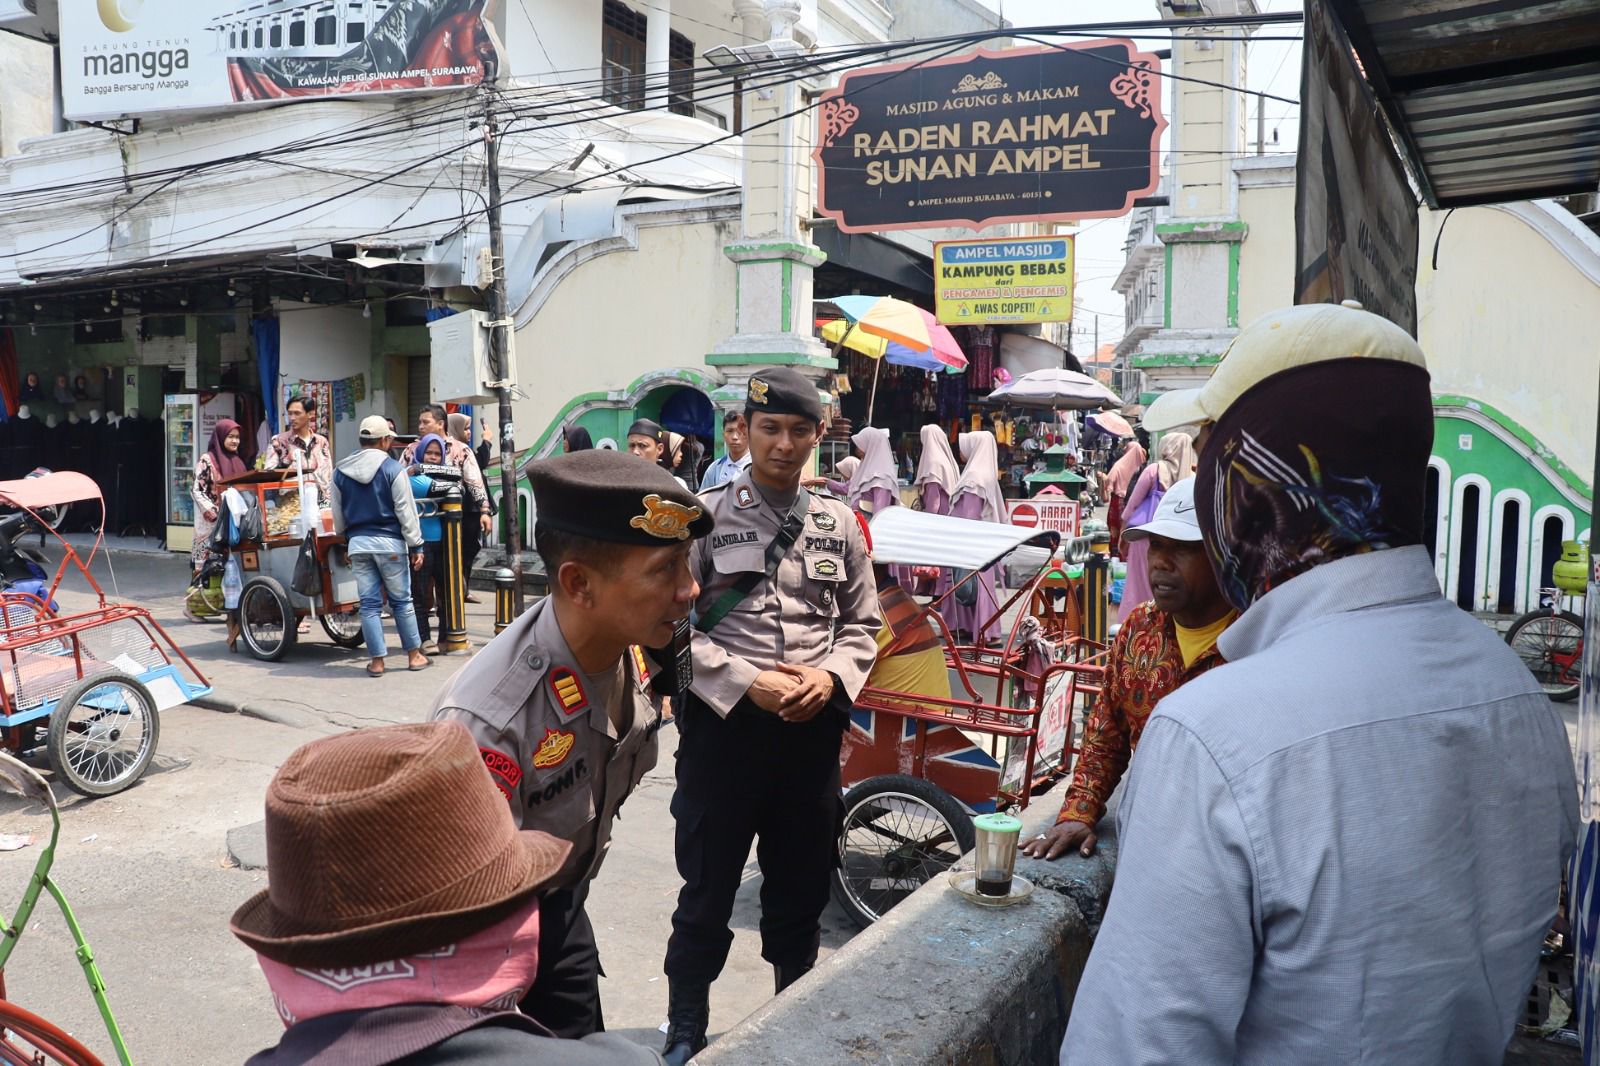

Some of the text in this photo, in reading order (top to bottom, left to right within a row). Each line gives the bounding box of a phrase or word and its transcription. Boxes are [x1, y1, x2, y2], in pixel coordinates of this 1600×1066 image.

[83, 38, 190, 52] SARUNG TENUN
[84, 48, 189, 78] mangga
[298, 65, 477, 86] KAWASAN RELIGI SUNAN AMPEL SURABAYA
[84, 79, 189, 95] Bangga Bersarung Mangga
[886, 85, 1080, 117] MASJID AGUNG & MAKAM
[854, 109, 1116, 158] RADEN RAHMAT
[865, 143, 1101, 186] SUNAN AMPEL
[917, 197, 944, 207] AMPEL
[945, 195, 973, 206] MASJID
[974, 193, 1015, 203] SURABAYA
[1022, 191, 1042, 199] 60151
[955, 243, 1053, 259] AMPEL MASJID
[942, 262, 1066, 278] KAMPUNG BEBAS
[995, 278, 1013, 286] dari
[943, 286, 1067, 299] PENGAMEN & PENGEMIS
[974, 302, 1035, 314] AWAS COPET!!
[1041, 506, 1073, 519] HARAP
[1041, 519, 1073, 533] TURUN
[805, 536, 845, 553] POLRI
